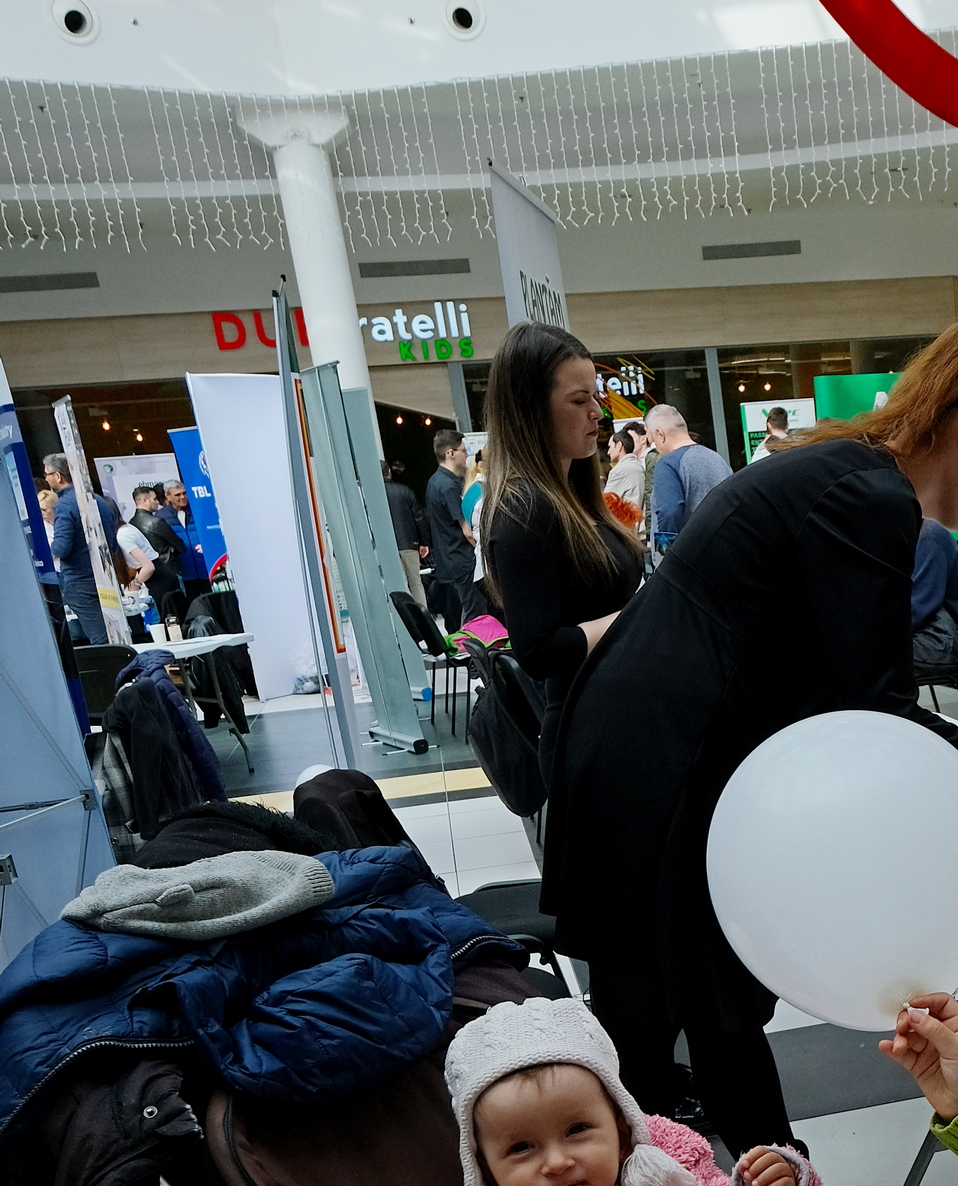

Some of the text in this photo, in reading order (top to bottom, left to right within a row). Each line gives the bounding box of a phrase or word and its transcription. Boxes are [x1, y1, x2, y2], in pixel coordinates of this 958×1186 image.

[358, 301, 471, 342] ratelli
[399, 338, 474, 361] KIDS
[191, 485, 212, 498] TBL
